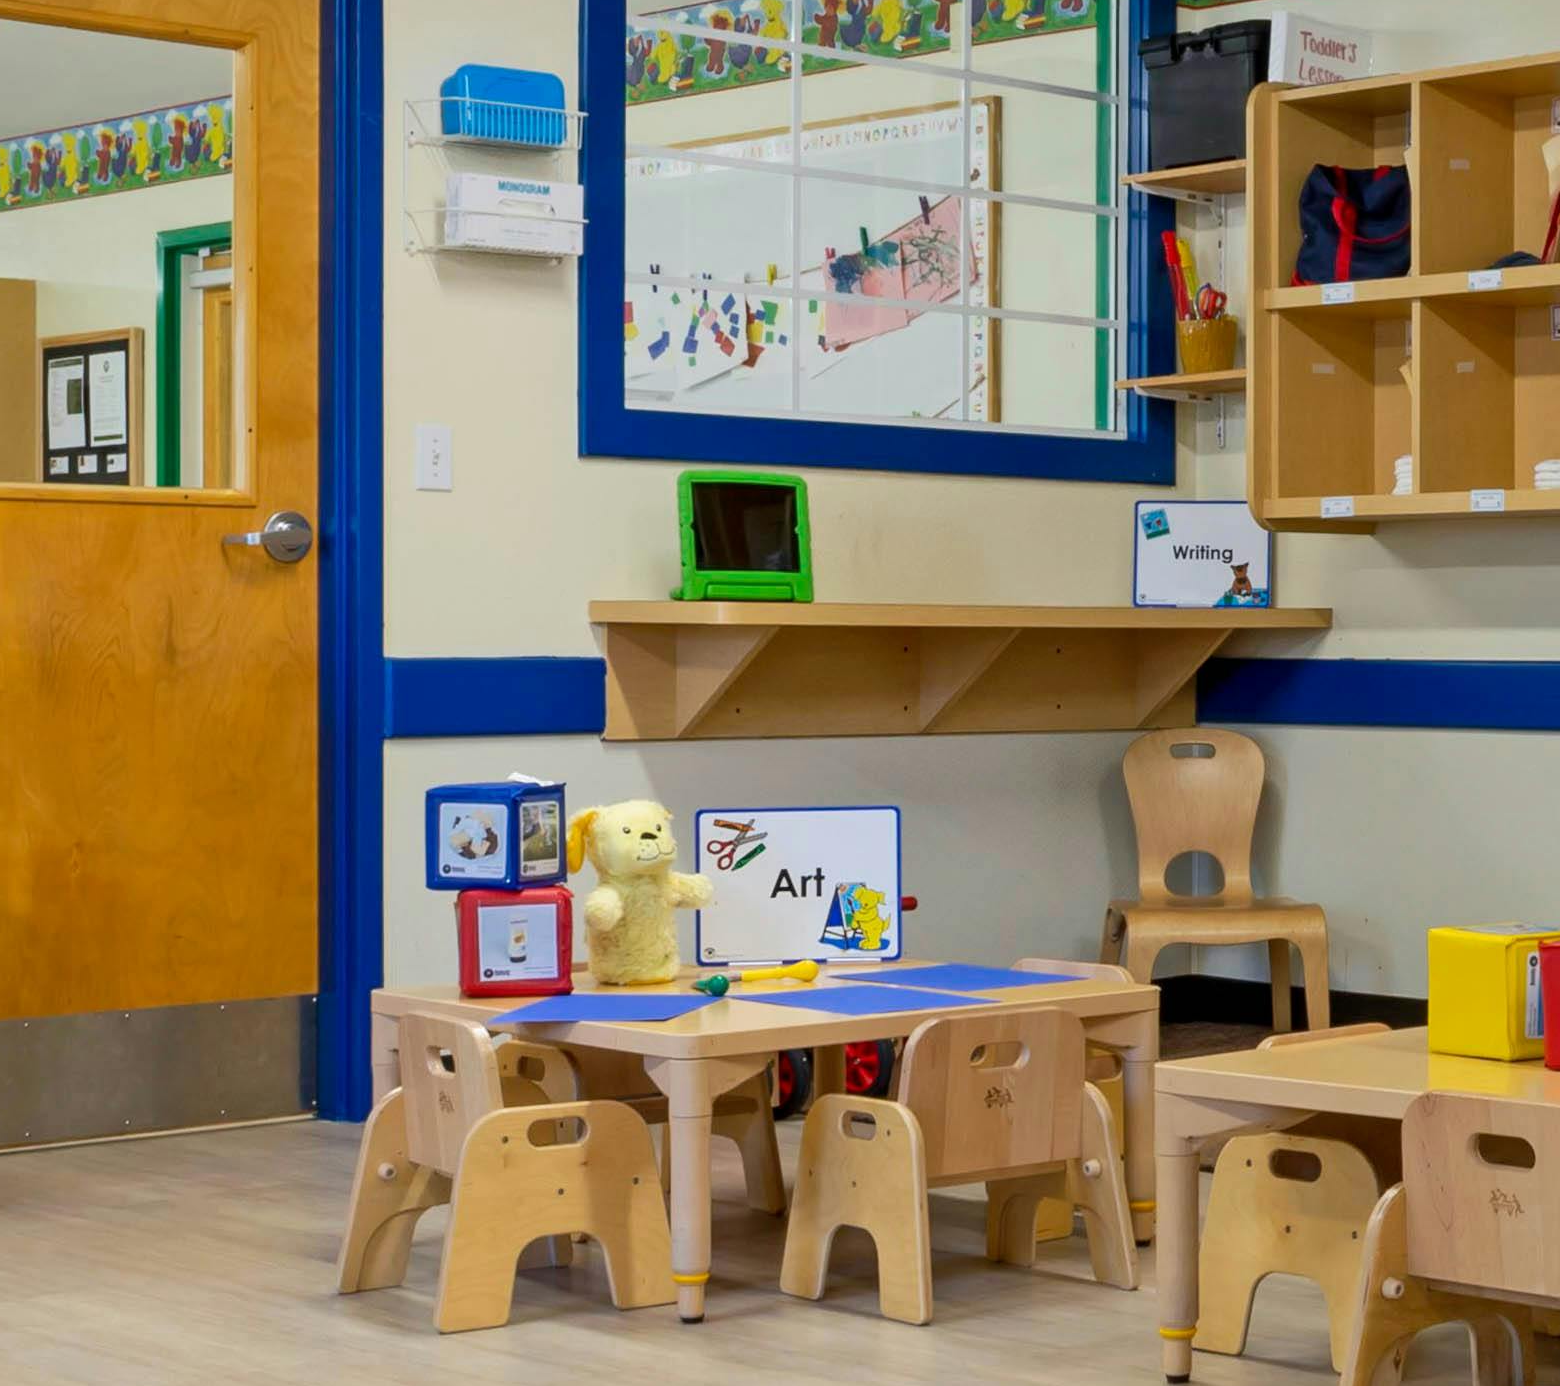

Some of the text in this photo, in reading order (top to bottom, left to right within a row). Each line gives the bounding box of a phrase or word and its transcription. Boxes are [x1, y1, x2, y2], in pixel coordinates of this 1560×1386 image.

[497, 180, 551, 196] MONOGRAM
[1173, 545, 1234, 564] Writing
[770, 867, 826, 899] Art
